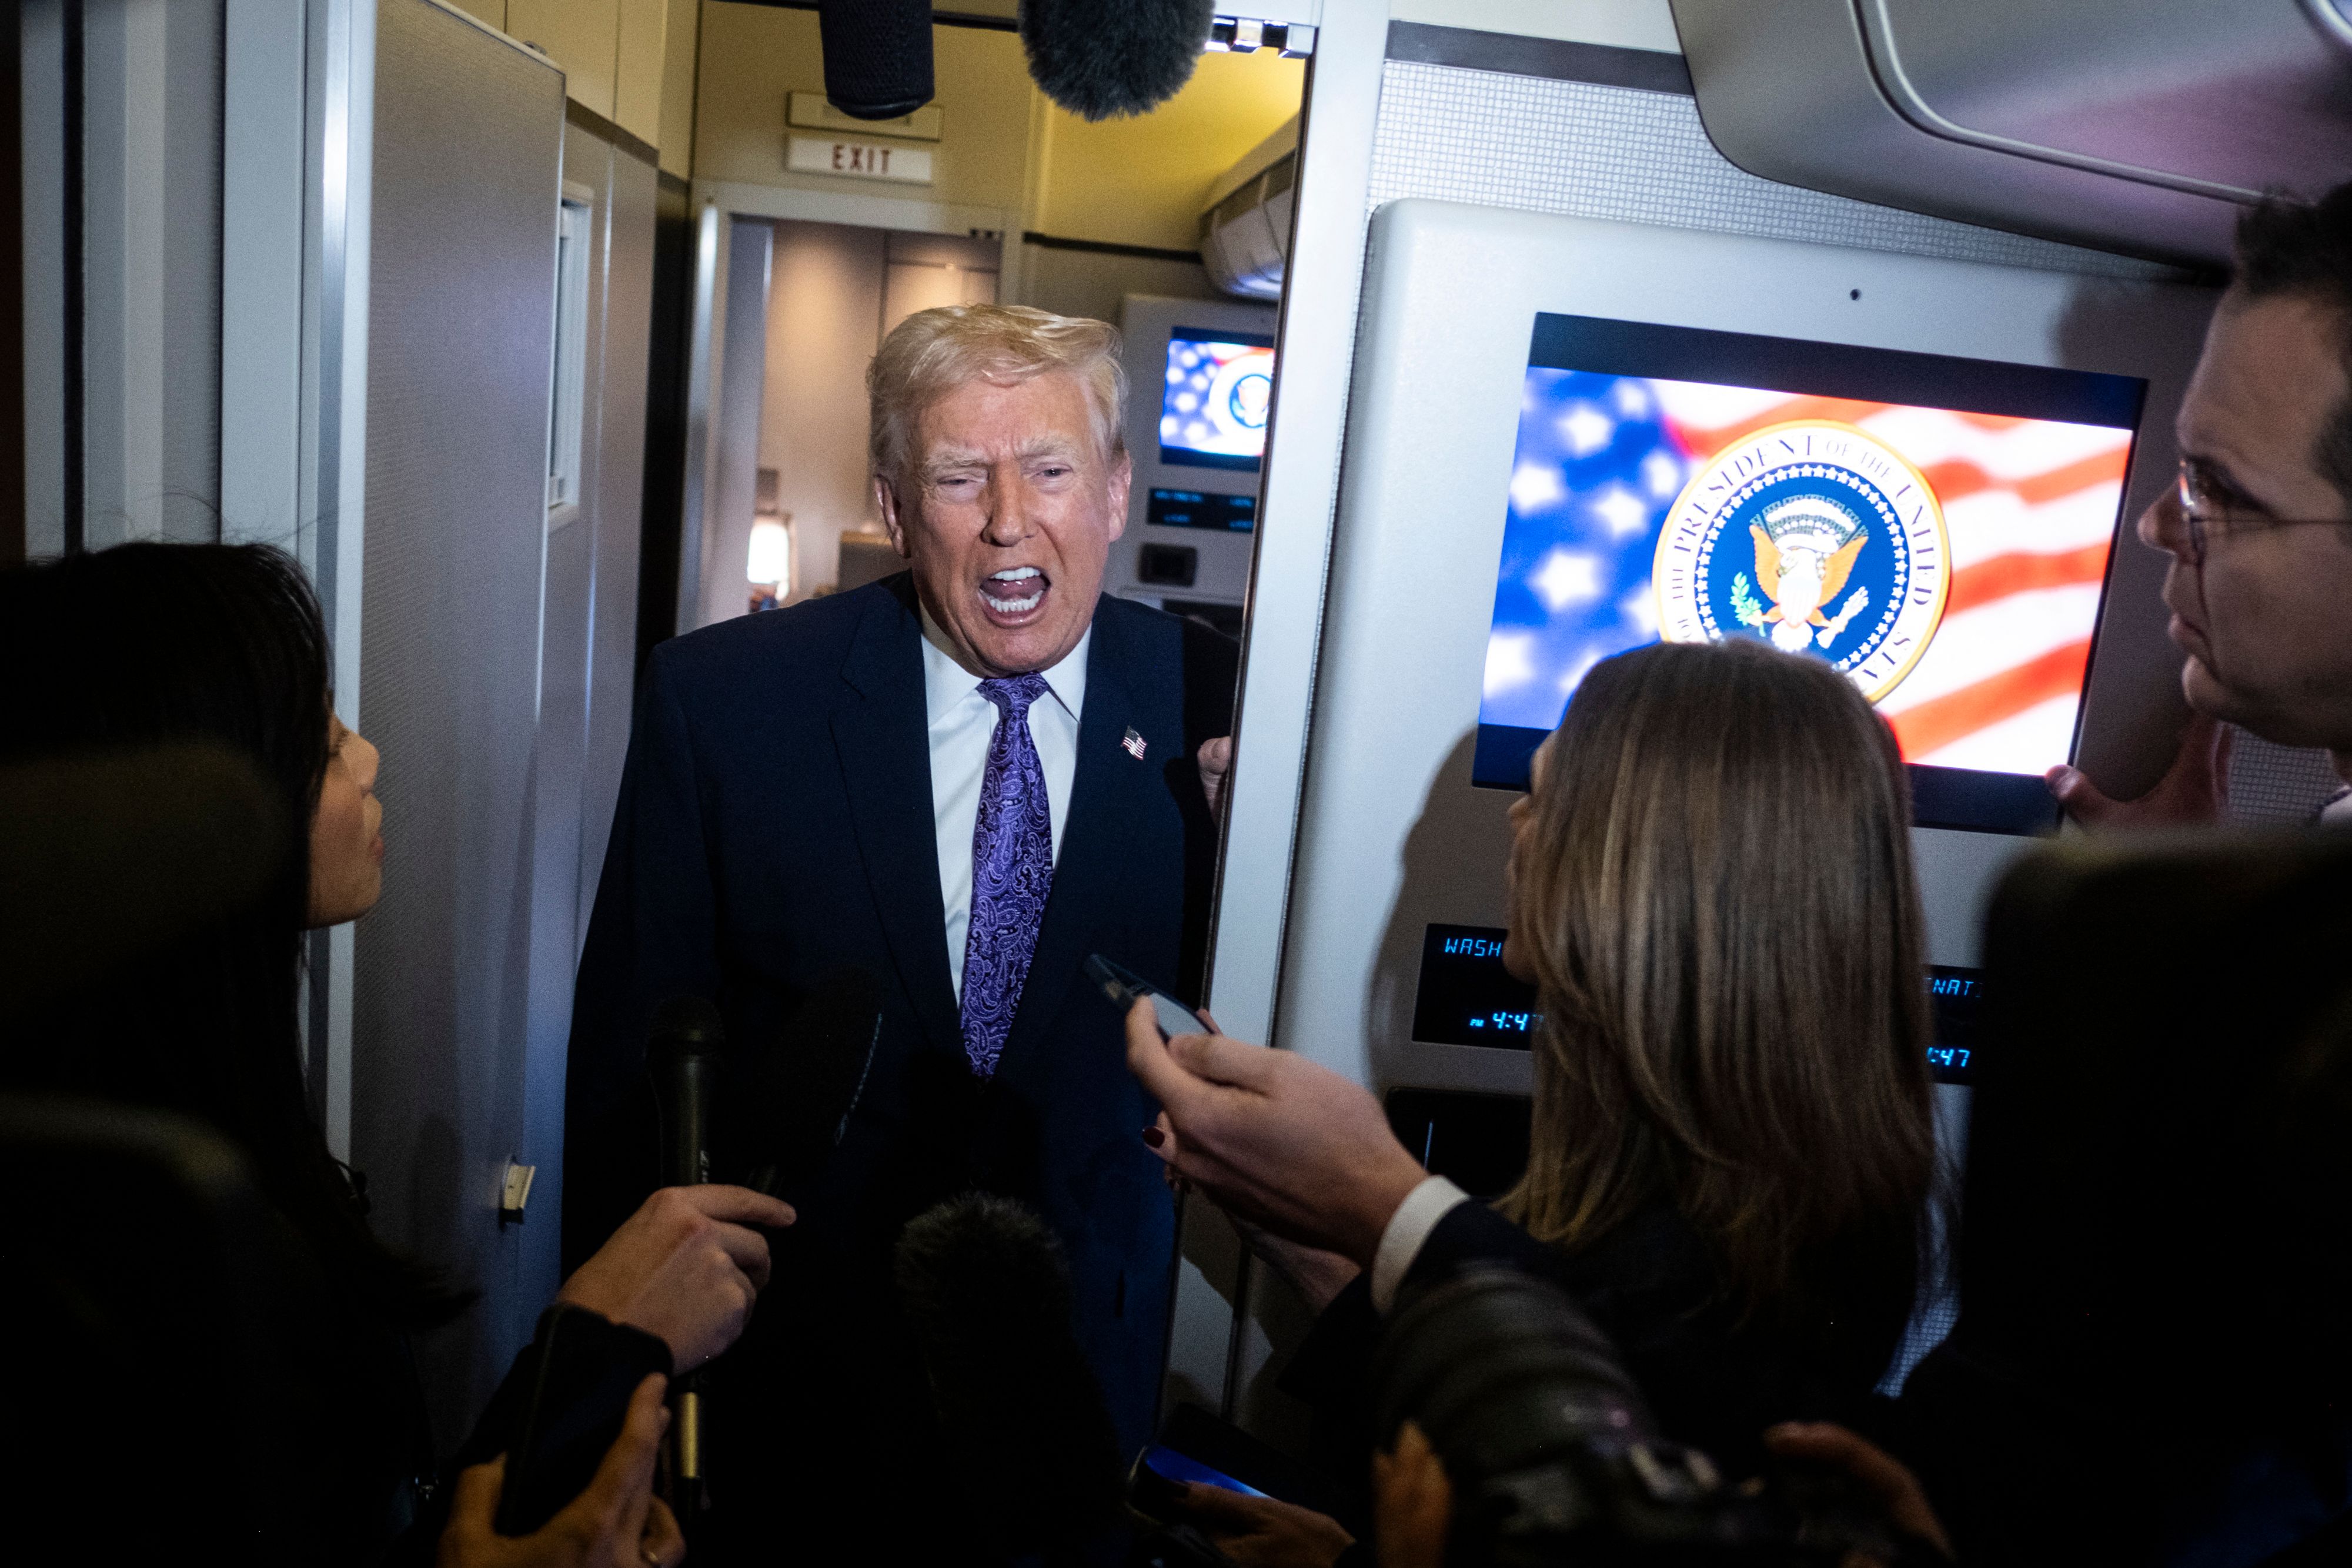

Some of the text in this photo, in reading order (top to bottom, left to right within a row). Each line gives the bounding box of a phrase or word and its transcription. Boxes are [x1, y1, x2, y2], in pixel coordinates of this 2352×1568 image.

[831, 145, 893, 175] EXIT
[1826, 440, 1852, 457] OF
[1859, 450, 1892, 480] THE
[1673, 434, 1818, 553] PRESIDENT
[1896, 484, 1935, 606] UNITED
[1862, 631, 1911, 681] STA
[1445, 938, 1502, 958] WASH
[1470, 1011, 1541, 1032] PM 4:4
